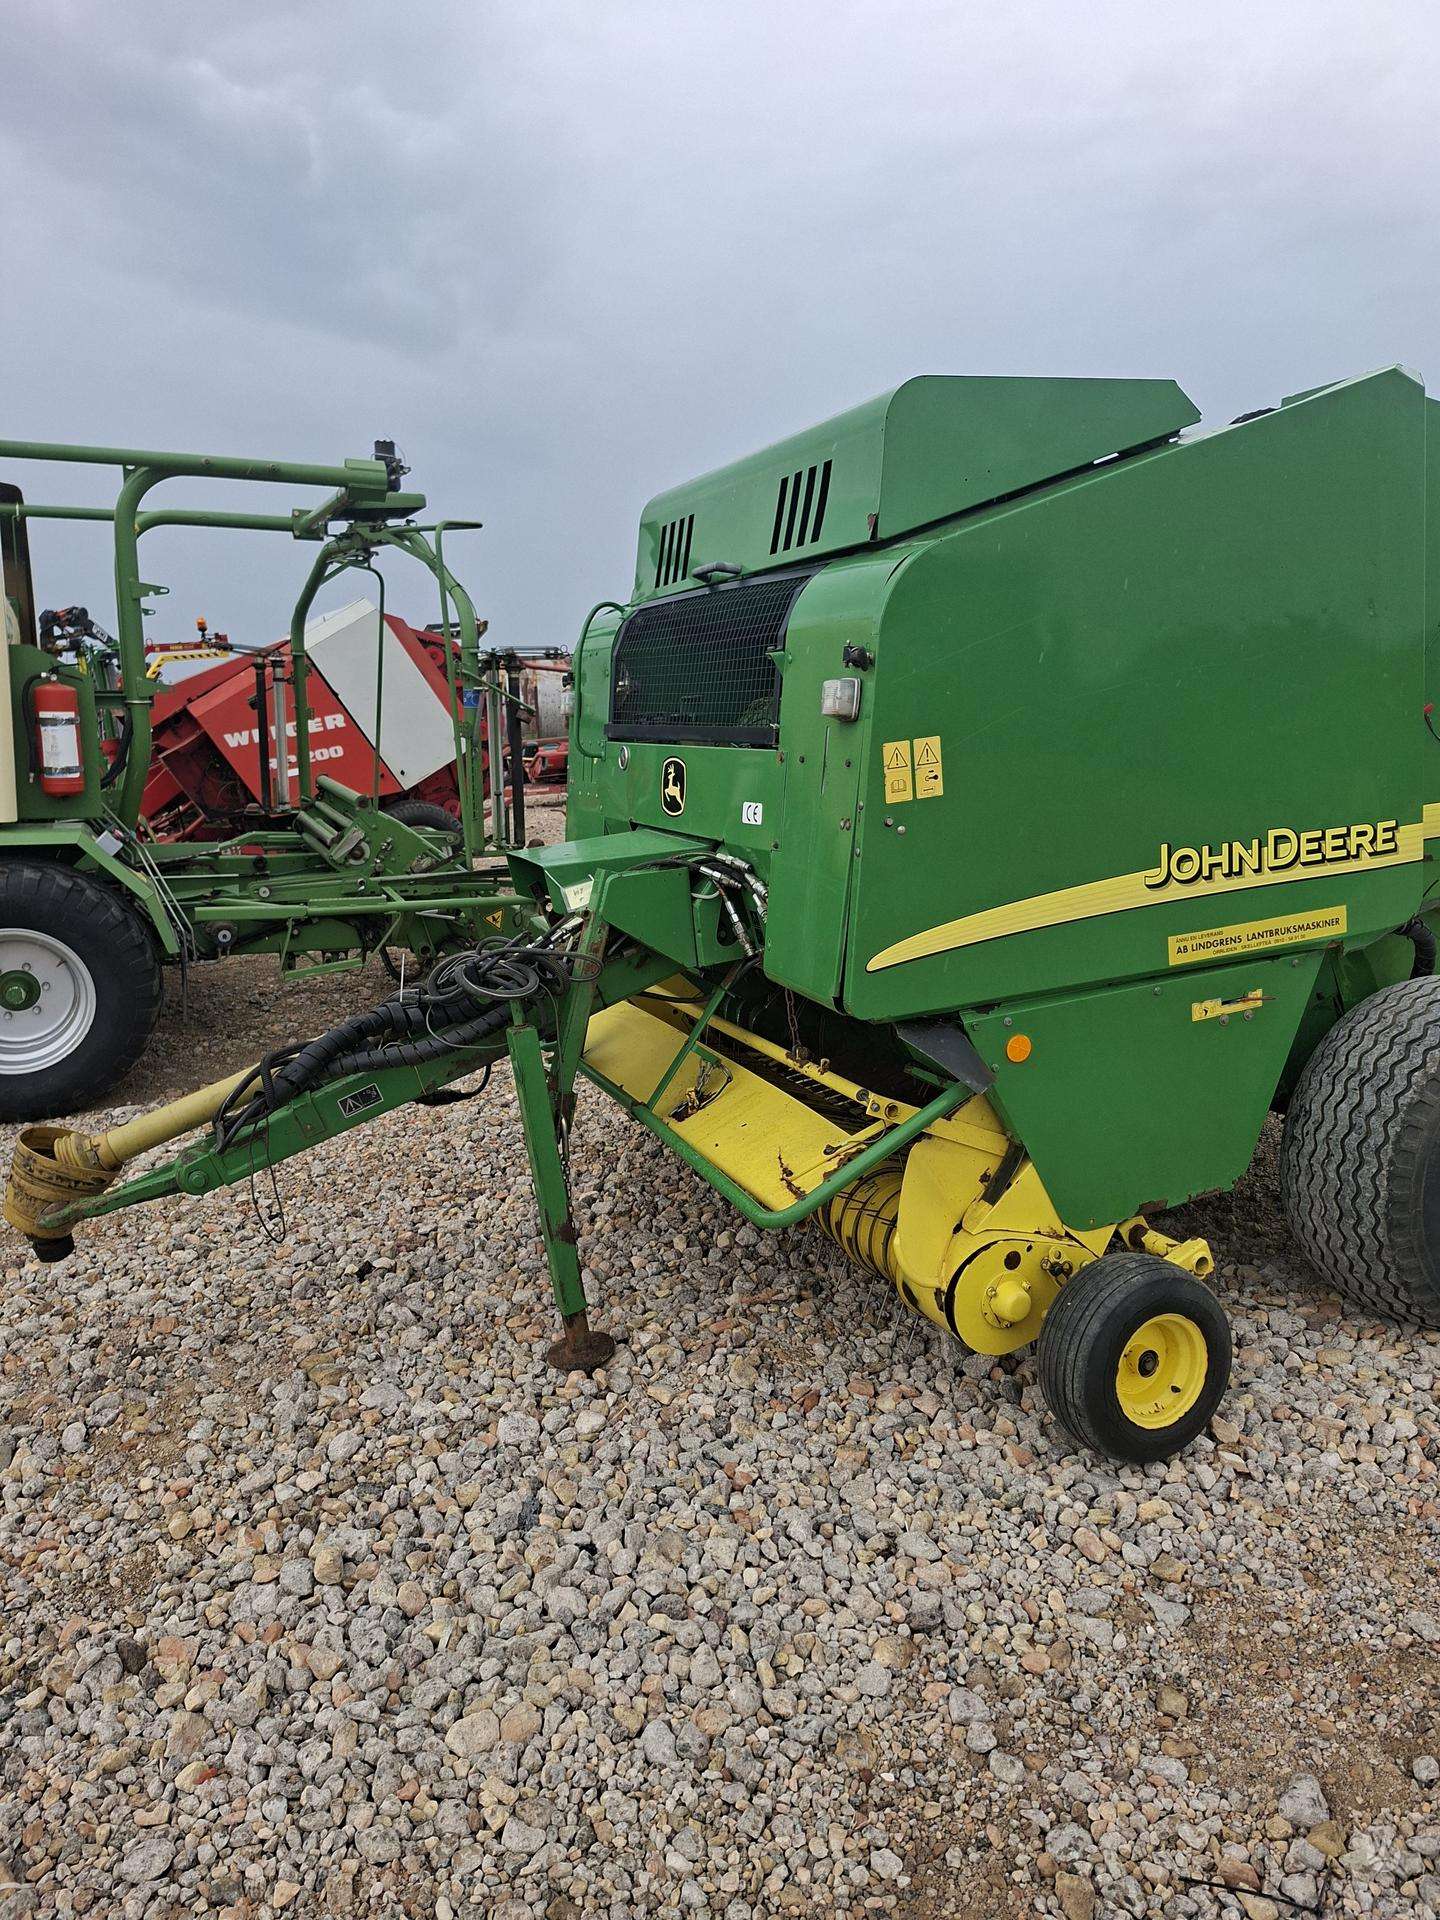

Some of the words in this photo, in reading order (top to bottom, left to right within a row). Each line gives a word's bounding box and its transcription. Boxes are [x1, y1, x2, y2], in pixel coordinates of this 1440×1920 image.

[1143, 839, 1263, 888] JOHN
[1266, 819, 1398, 871] DEERE
[1176, 945, 1189, 954] AB
[1191, 934, 1243, 952] LINDGRENS
[1246, 917, 1340, 942] LANTBRUKSMASKINER
